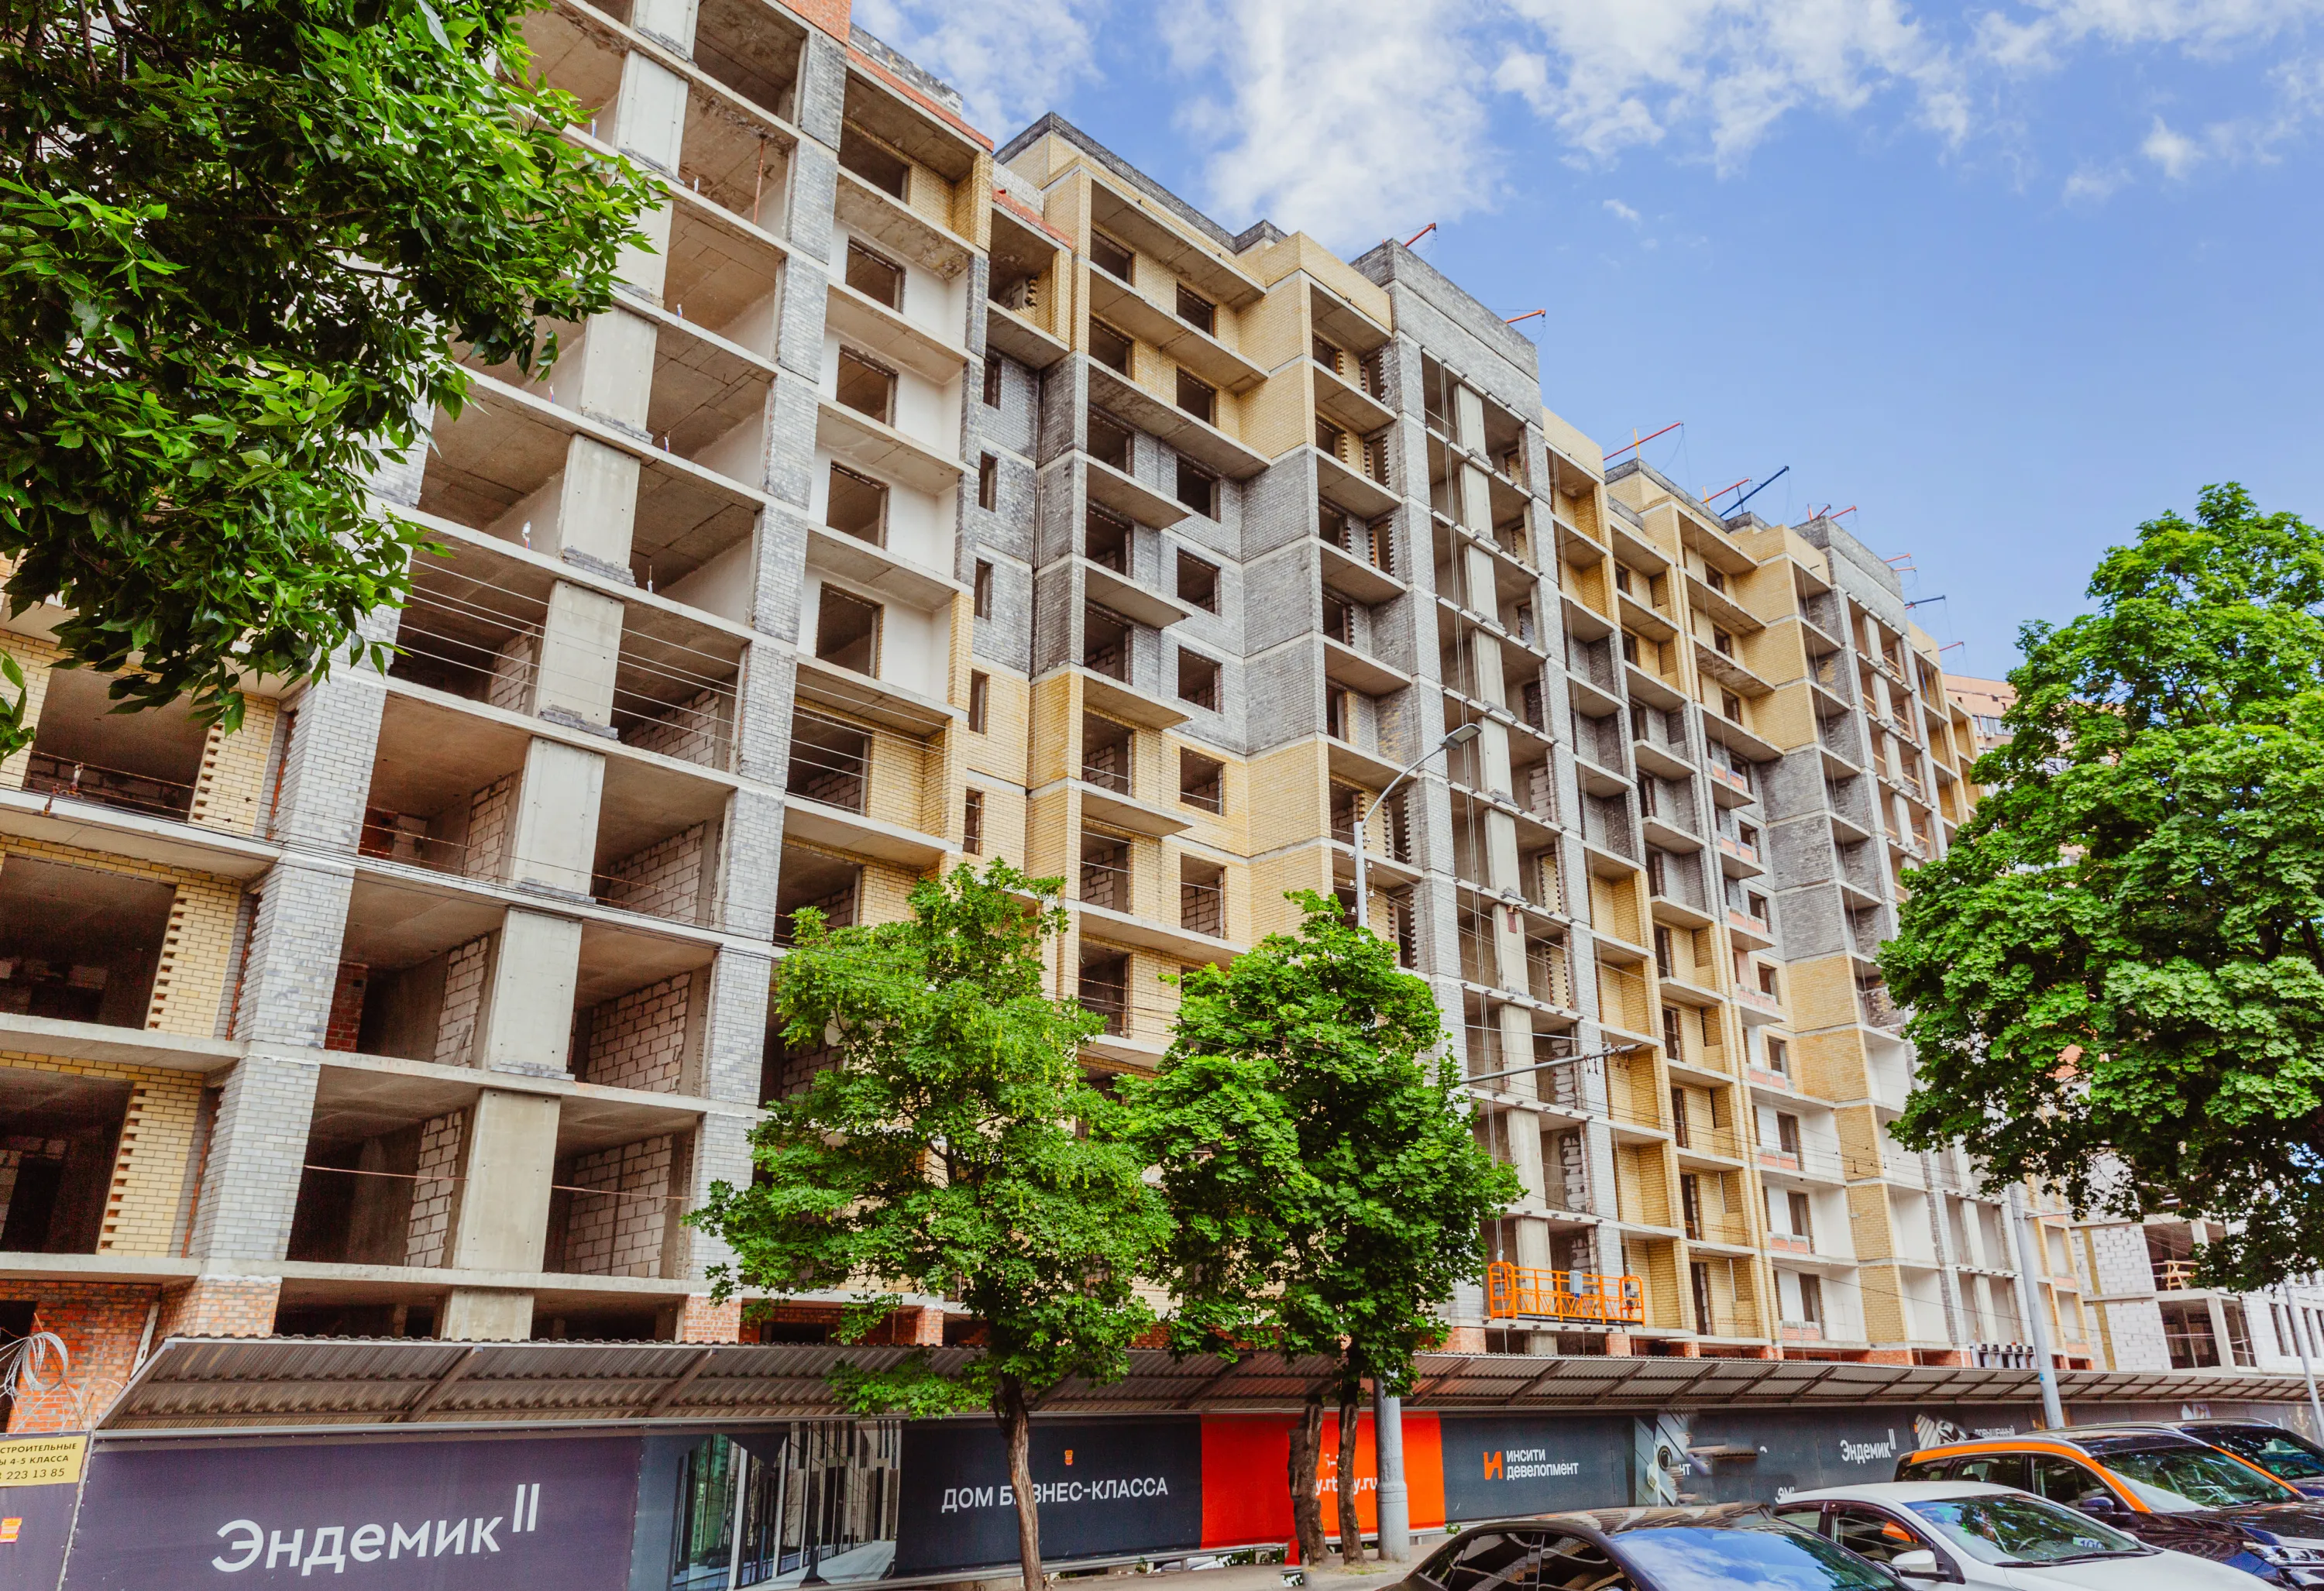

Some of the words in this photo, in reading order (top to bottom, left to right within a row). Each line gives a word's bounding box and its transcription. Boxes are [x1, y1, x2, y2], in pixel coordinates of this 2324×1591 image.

[0, 1443, 77, 1453] СТРОИТЕЛЬНЫЕ
[1506, 1448, 1545, 1462] ИНСИТИ
[1840, 1439, 1891, 1464] Эндемик
[29, 1455, 69, 1464] КЛАССА
[6, 1470, 28, 1480] 223
[33, 1469, 46, 1479] 13
[50, 1468, 65, 1477] 85
[1506, 1462, 1579, 1481] девелопмент
[941, 1486, 993, 1514] ДОМ
[999, 1476, 1169, 1507] БЗНЕС-КЛАССА
[211, 1516, 504, 1576] Эндемик
